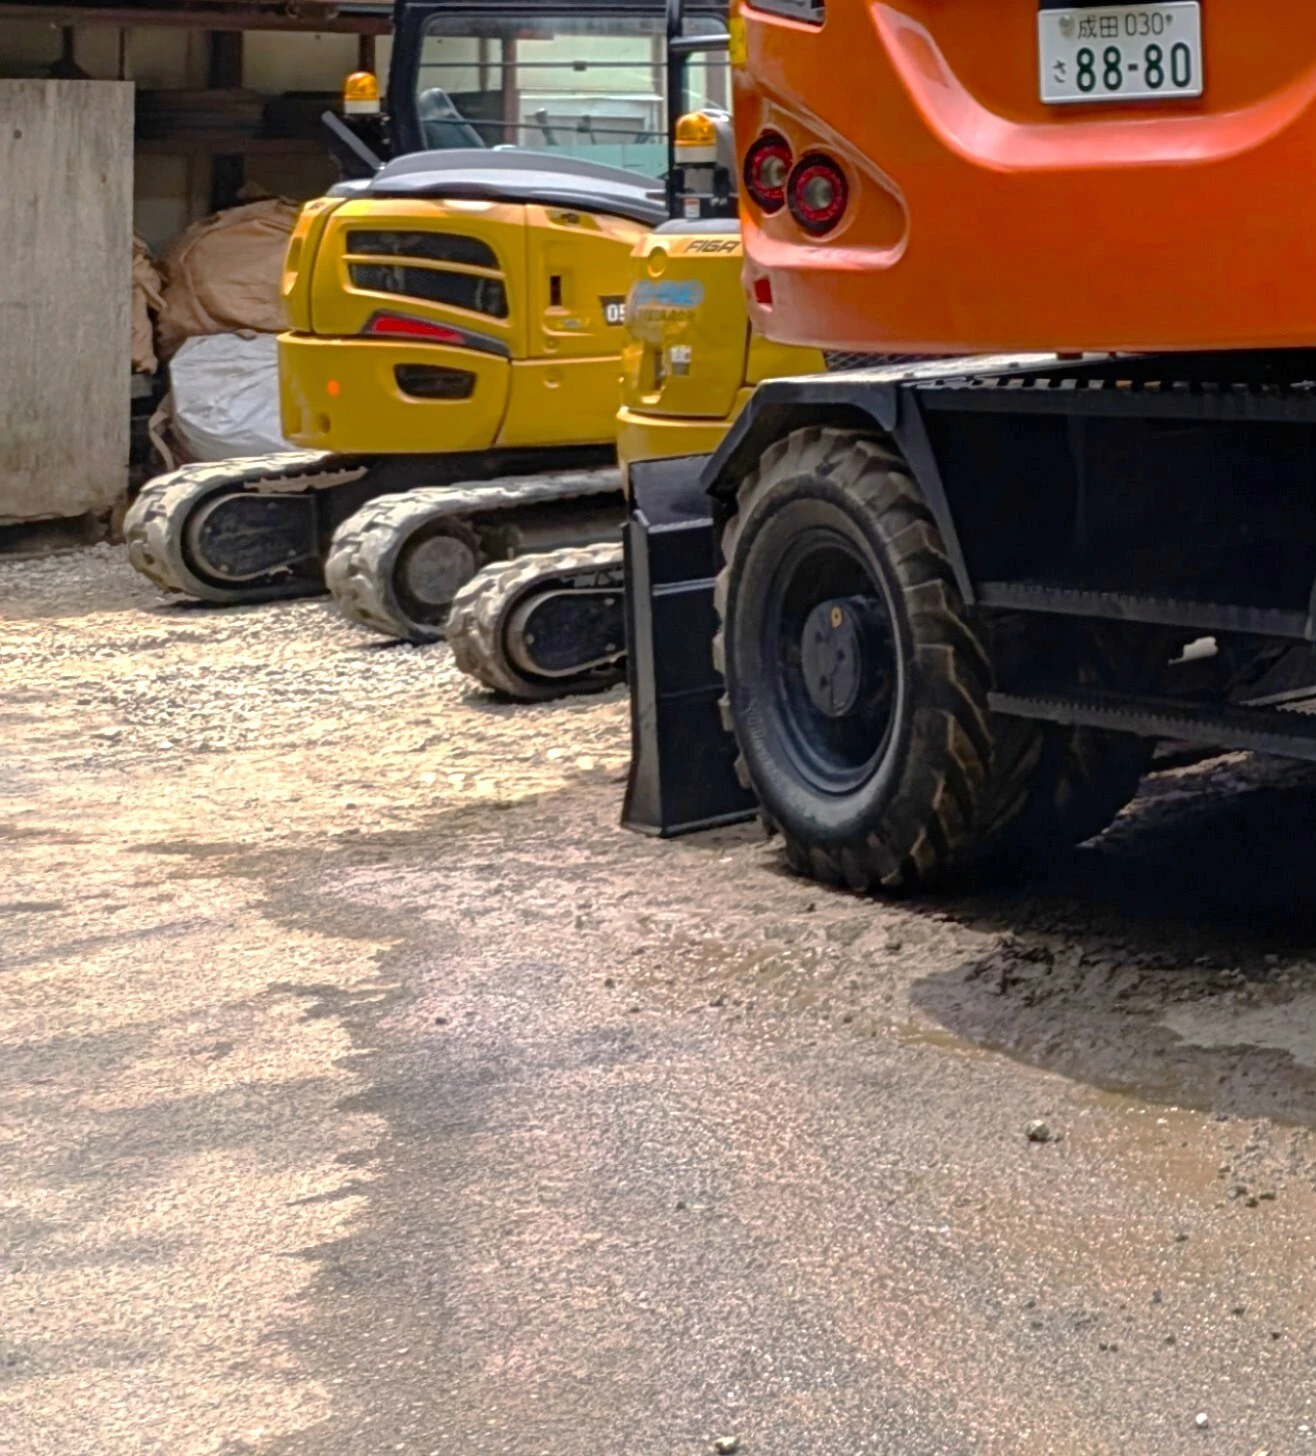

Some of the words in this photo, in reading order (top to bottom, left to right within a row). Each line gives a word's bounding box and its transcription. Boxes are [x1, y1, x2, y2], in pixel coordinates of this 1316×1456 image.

[1078, 15, 1118, 39] 成田
[1124, 12, 1164, 36] 030
[1076, 42, 1192, 92] 88-80
[685, 239, 739, 253] FIGA
